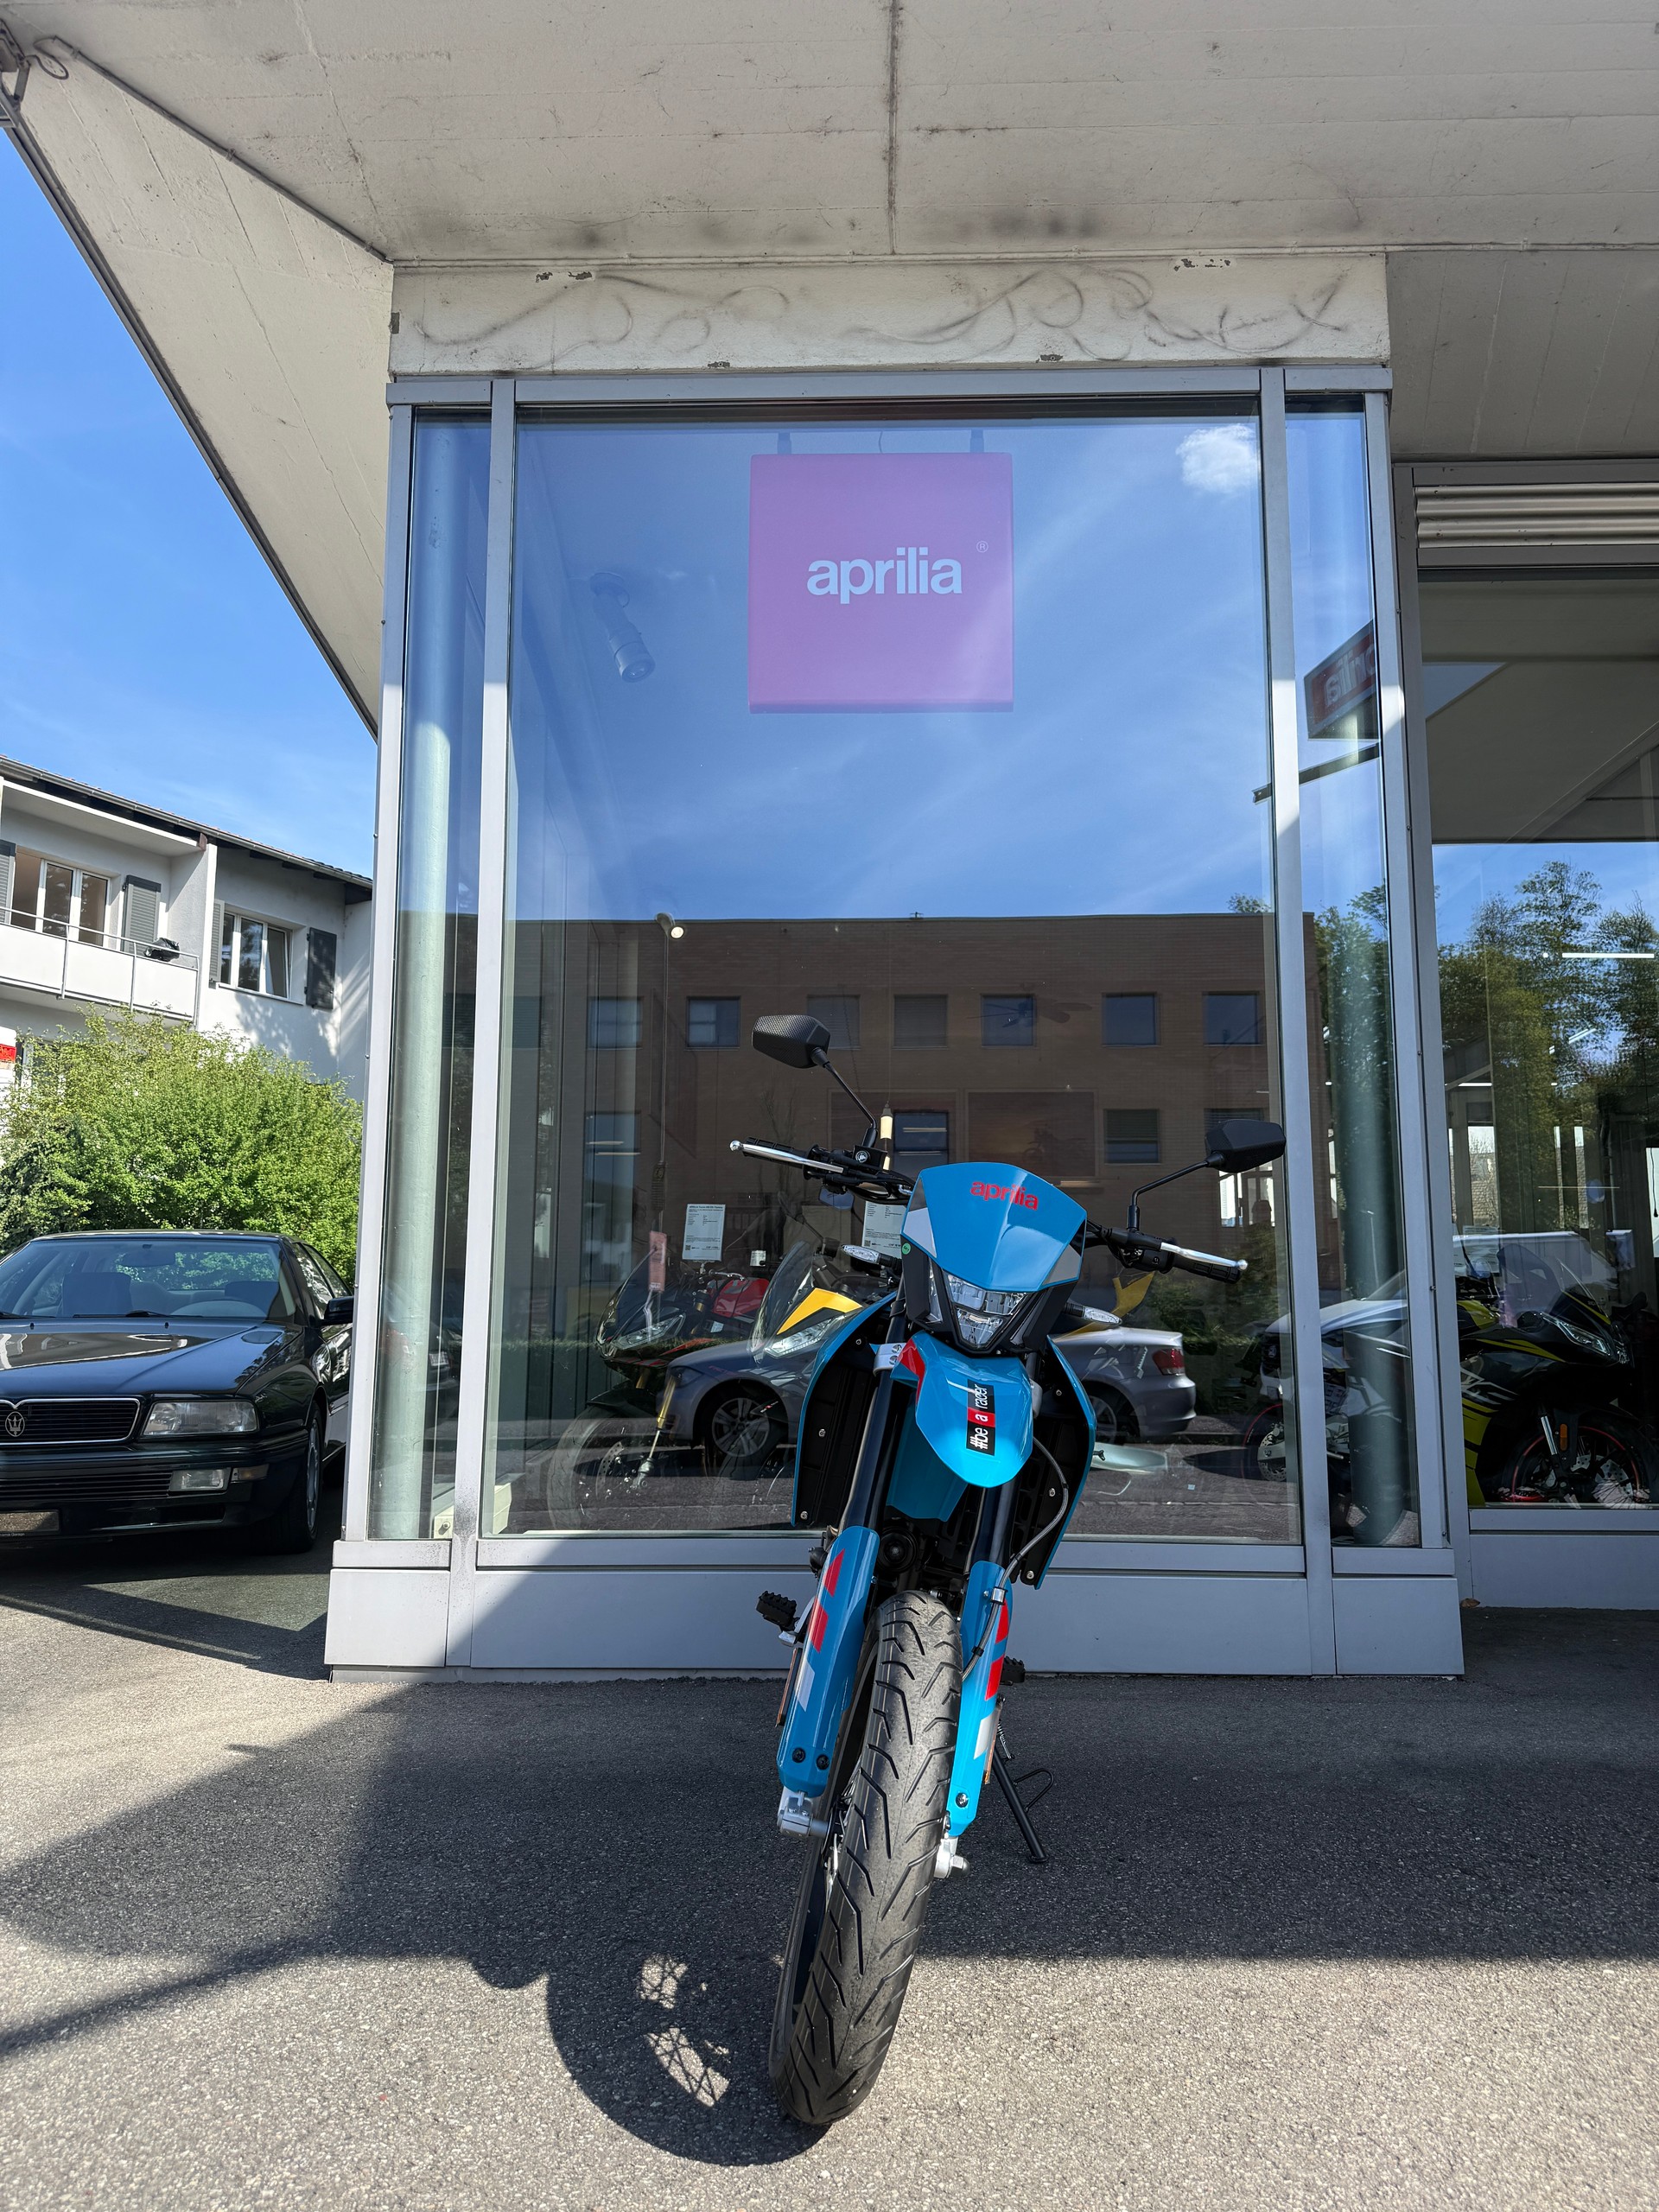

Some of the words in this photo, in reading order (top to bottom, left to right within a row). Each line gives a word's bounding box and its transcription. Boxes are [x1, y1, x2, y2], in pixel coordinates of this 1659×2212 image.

[807, 547, 963, 604] aprilia
[970, 1181, 1039, 1211] aprilia
[975, 1383, 988, 1409] racer
[975, 1413, 988, 1422] a
[969, 1427, 988, 1450] #be
